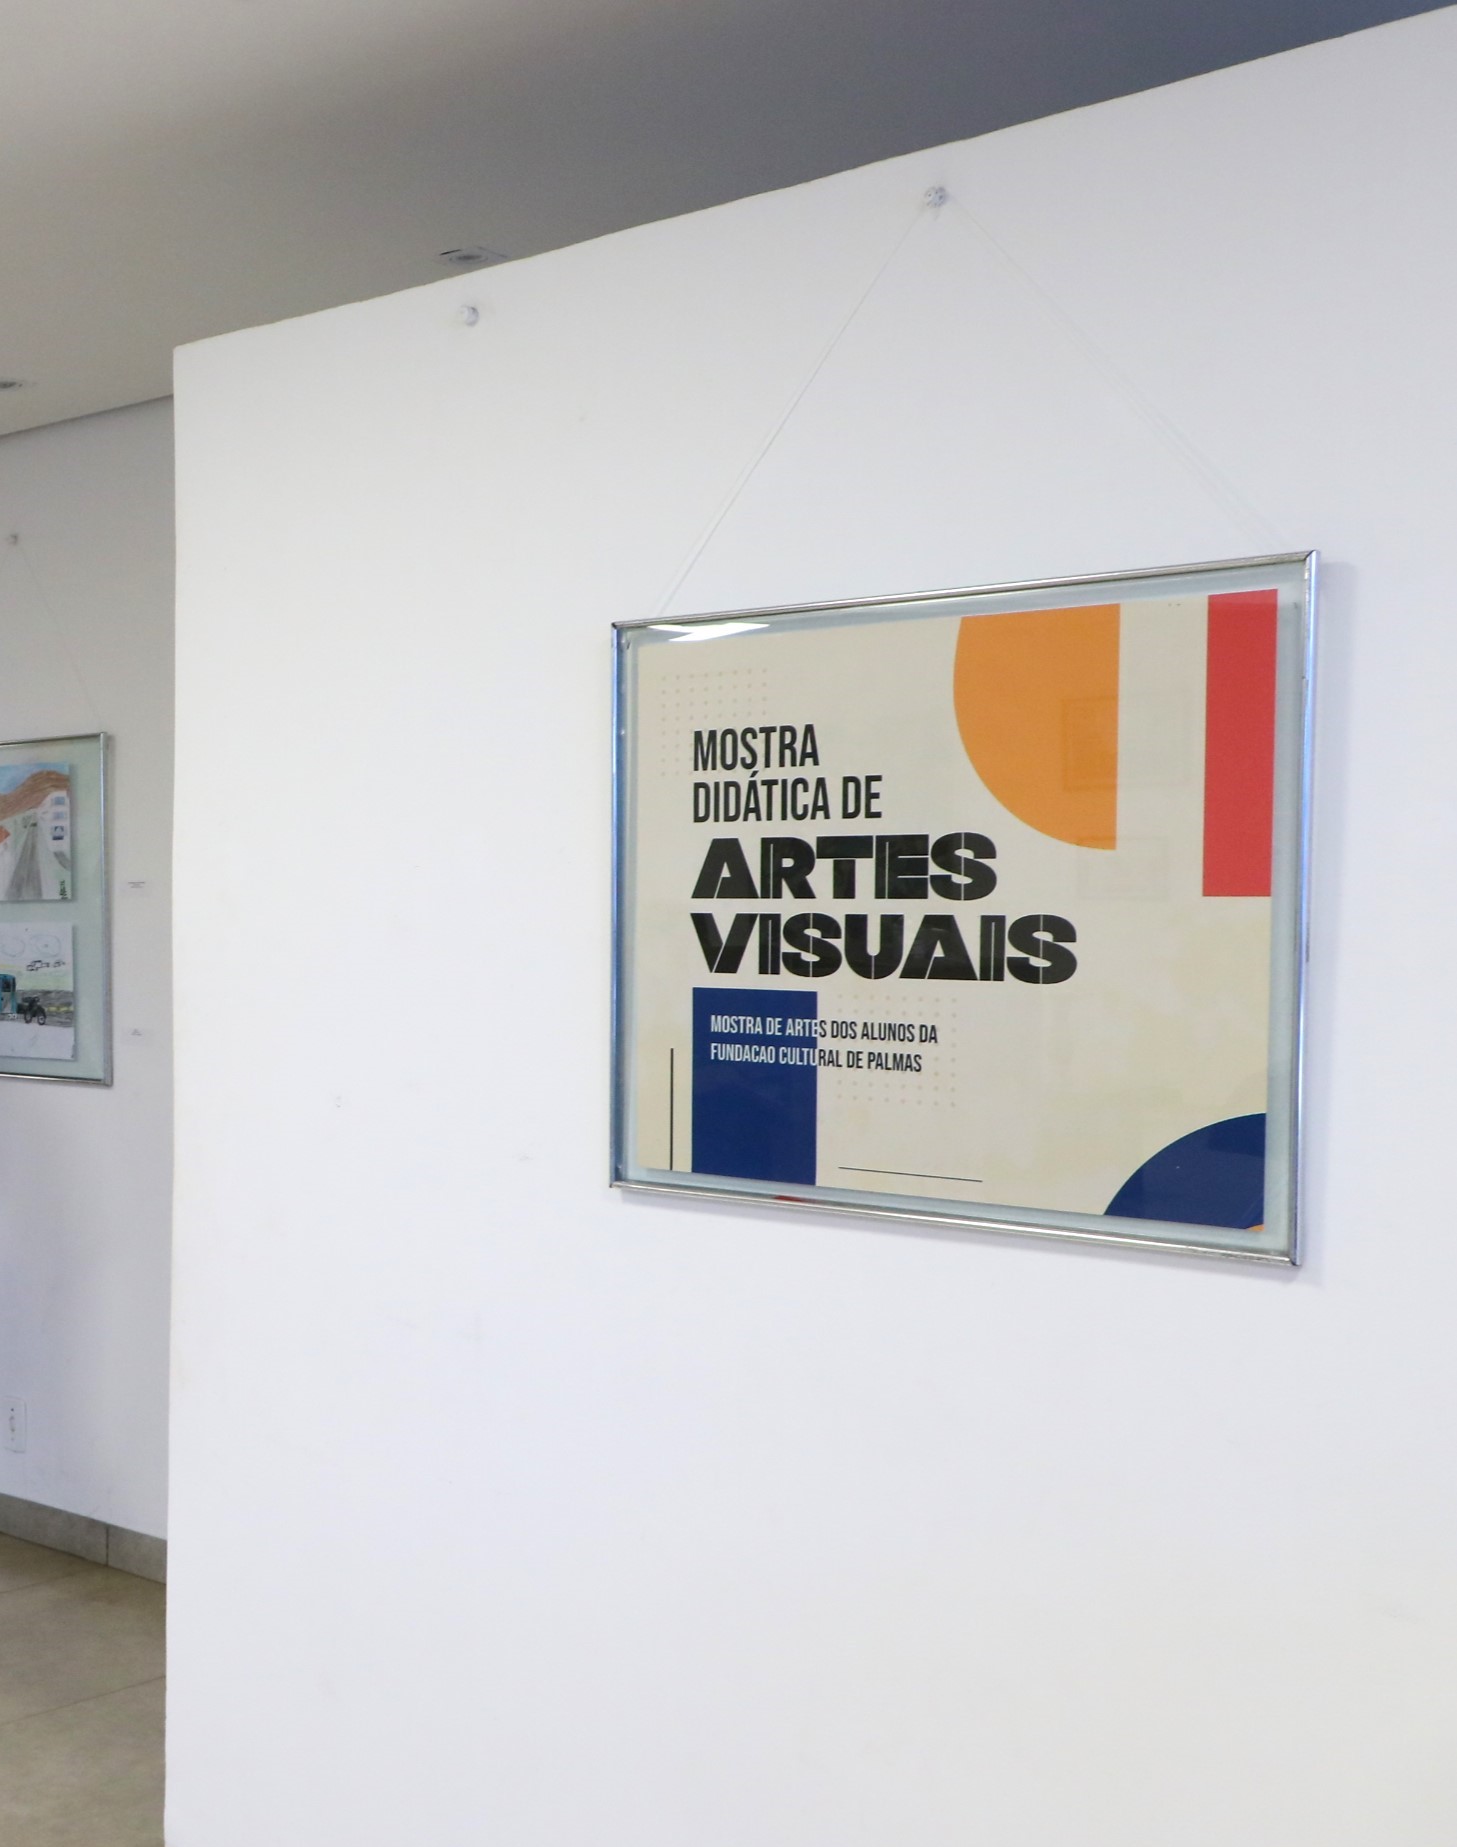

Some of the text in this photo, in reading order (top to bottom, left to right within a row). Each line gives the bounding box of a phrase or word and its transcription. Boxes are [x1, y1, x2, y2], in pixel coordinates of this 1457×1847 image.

[693, 724, 820, 771] MOSTRA
[693, 770, 883, 823] DIDÁTICA DE
[691, 832, 997, 901] ARTES
[690, 912, 1078, 985] VISUAIS
[710, 1014, 938, 1043] MOSTRA DE ARTES DOS ALUNOS DA
[779, 1047, 842, 1068] CULTURAL
[846, 1050, 863, 1069] DE
[867, 1051, 922, 1073] PALMAS
